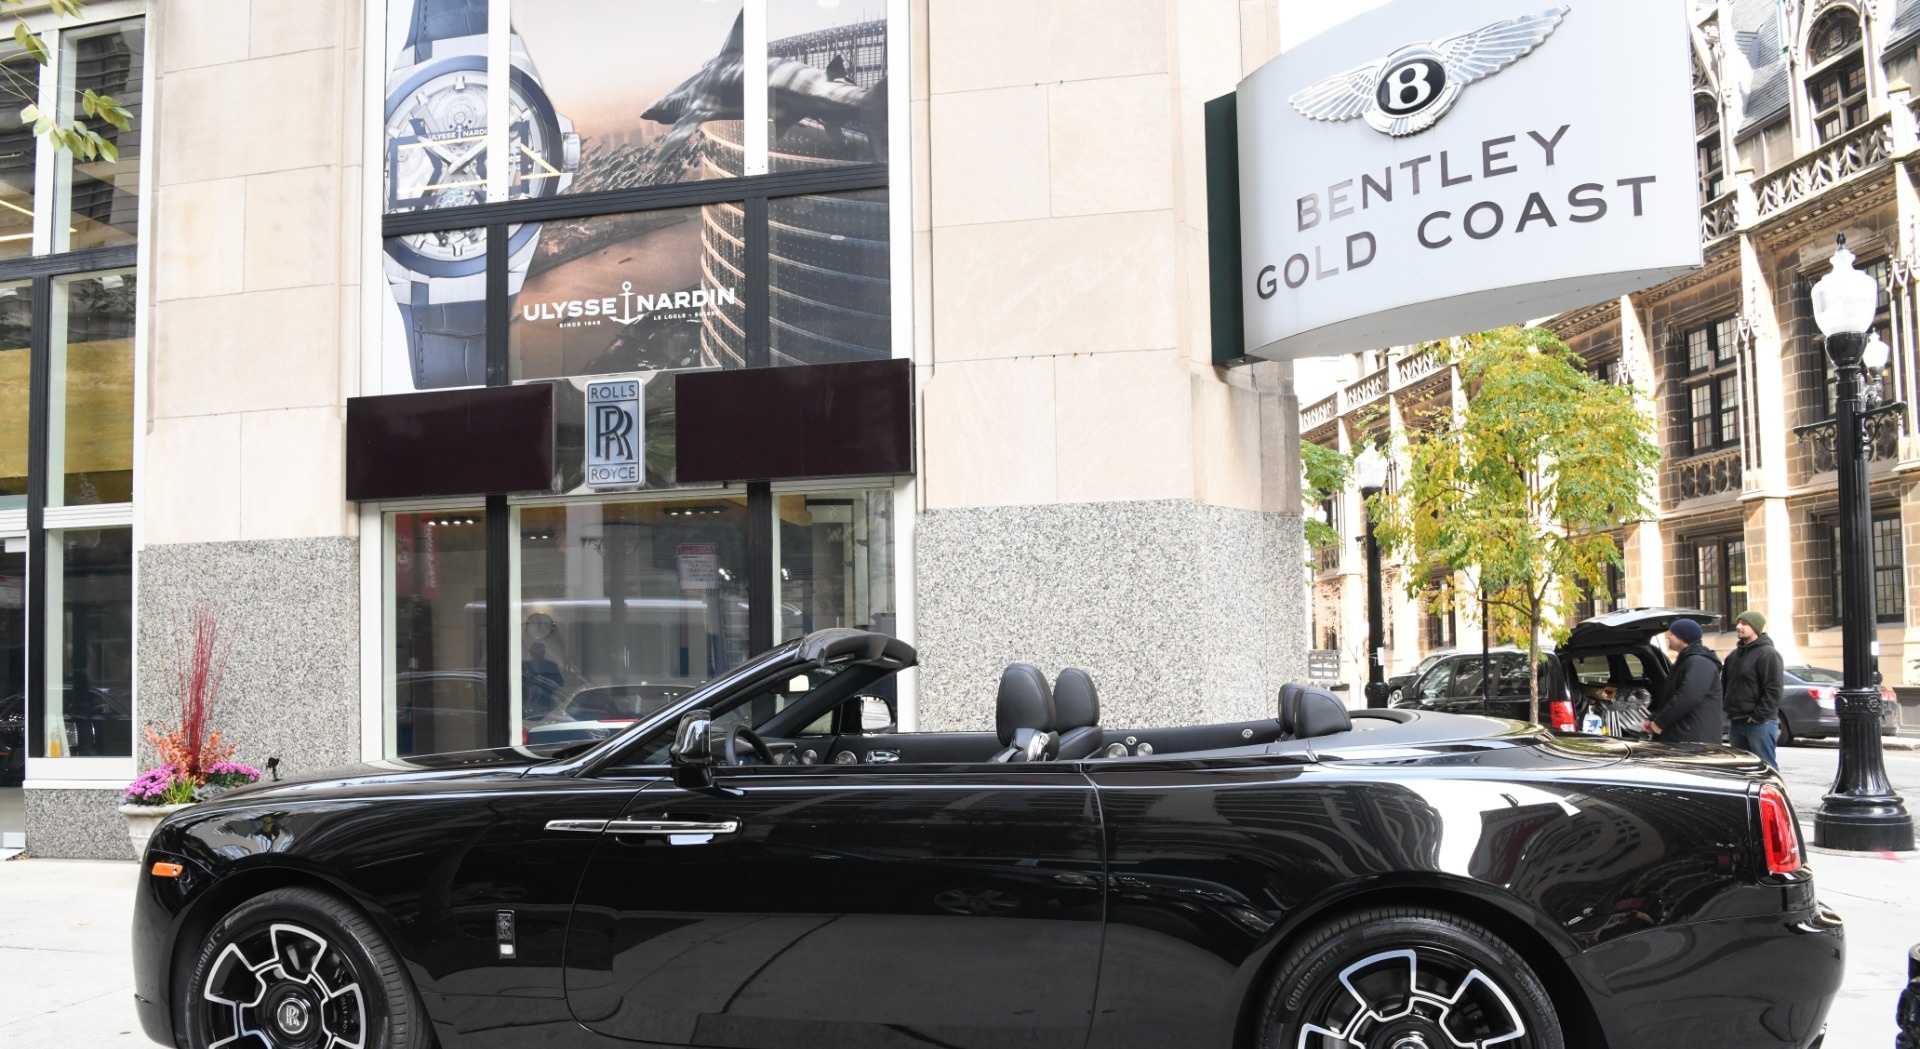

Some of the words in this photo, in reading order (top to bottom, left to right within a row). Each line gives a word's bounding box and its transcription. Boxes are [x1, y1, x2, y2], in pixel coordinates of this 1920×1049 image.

[1387, 62, 1431, 110] B
[462, 128, 488, 137] NARDI
[1296, 124, 1571, 233] BENTLEY
[1256, 230, 1377, 301] GOLD
[1416, 175, 1657, 250] COAST
[523, 297, 617, 321] ULYSSE
[637, 287, 735, 312] NARDIN
[591, 384, 635, 399] ROLLS
[591, 466, 636, 480] ROYCE
